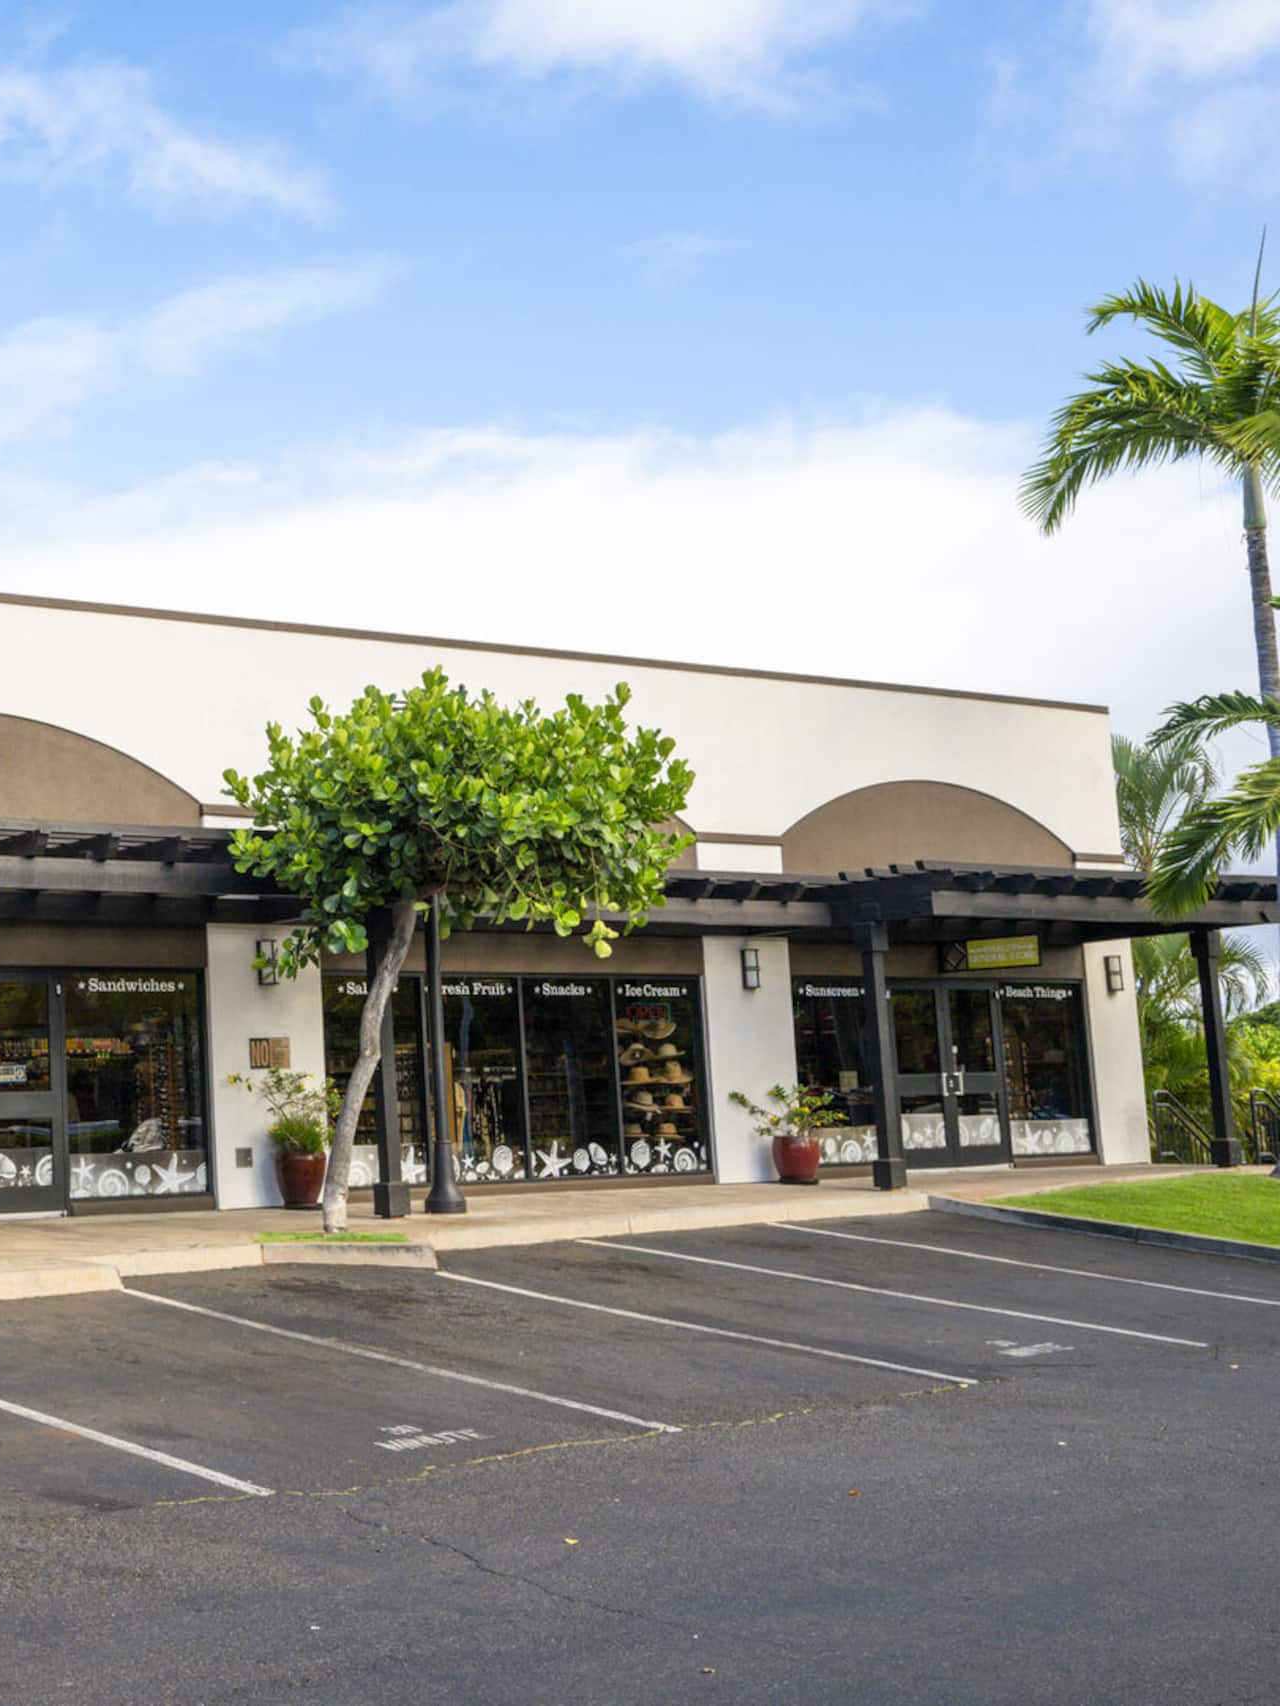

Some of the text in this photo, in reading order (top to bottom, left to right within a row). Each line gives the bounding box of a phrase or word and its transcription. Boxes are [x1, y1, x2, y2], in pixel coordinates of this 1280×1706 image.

[87, 977, 177, 993] Sandwiches
[345, 981, 369, 996] Sal
[441, 981, 506, 996] resh Fruit
[541, 982, 586, 996] Snacks
[624, 983, 681, 998] Ice Cream
[804, 983, 860, 997] Sunscreen
[1005, 985, 1067, 1000] Beach Things
[250, 1040, 270, 1067] NO
